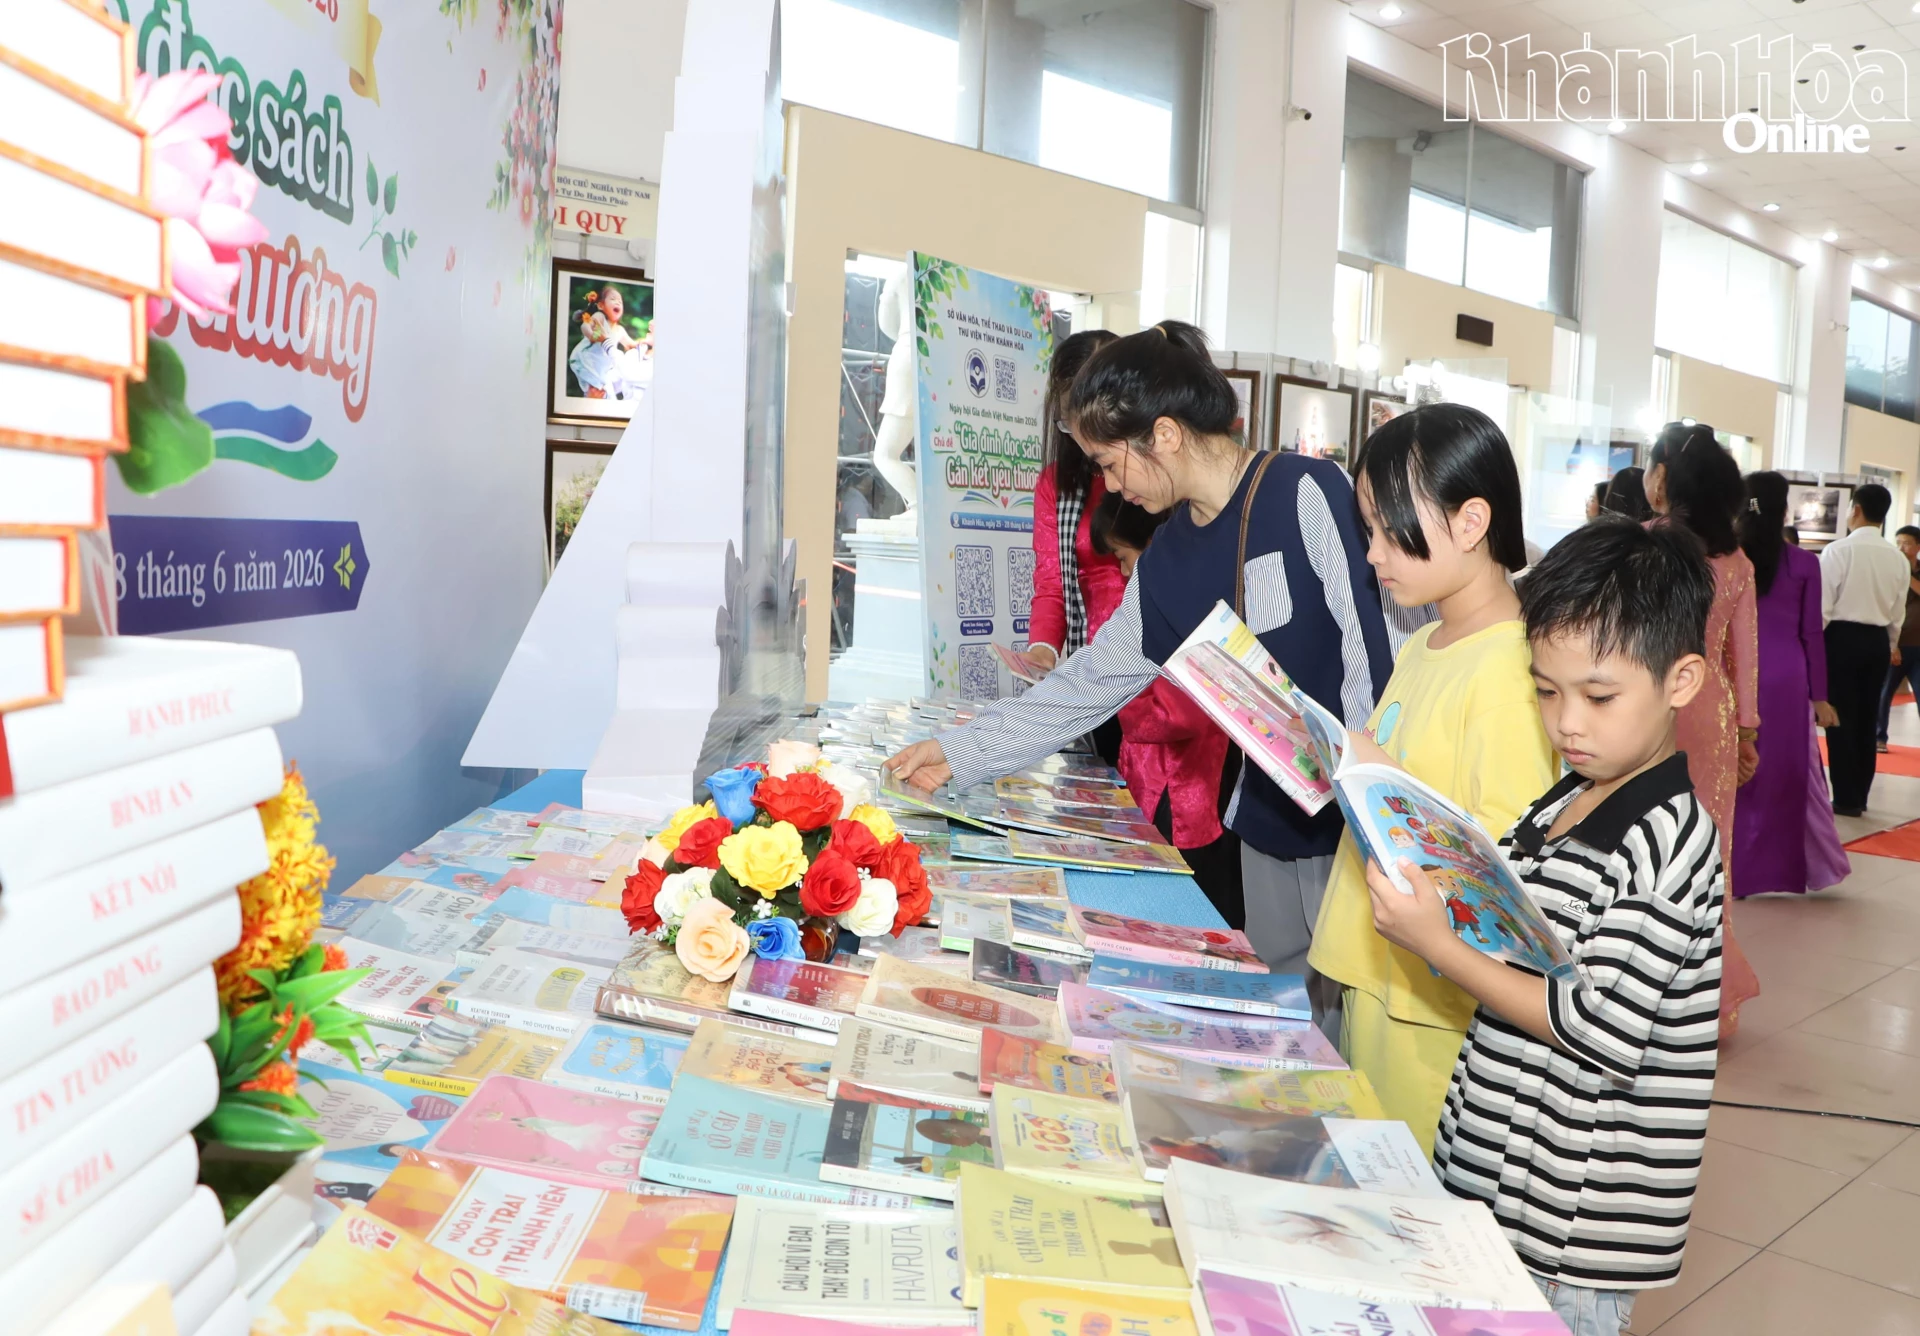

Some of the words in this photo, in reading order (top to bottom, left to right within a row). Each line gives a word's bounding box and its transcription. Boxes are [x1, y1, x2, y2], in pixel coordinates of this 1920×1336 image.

[255, 76, 352, 215] sách
[574, 190, 584, 198] Do
[591, 182, 614, 193] NGHĨA
[616, 187, 633, 197] VIỆT
[635, 190, 650, 199] NAM
[576, 209, 627, 235] QUY
[198, 240, 375, 416] ương
[992, 321, 1005, 332] THAO
[1006, 324, 1013, 334] VÀ
[1014, 327, 1021, 336] DU
[1022, 330, 1032, 340] LỊCH
[996, 336, 1013, 348] KHÁNH
[949, 402, 962, 414] Ngày
[972, 406, 980, 416] Gia
[981, 408, 992, 418] đình
[993, 410, 1002, 422] Việt
[1003, 412, 1014, 422] Nam
[1014, 414, 1024, 424] năm
[1025, 416, 1038, 427] 2026
[934, 436, 945, 447] Chủ
[946, 436, 953, 448] đề
[981, 428, 1000, 455] đình
[1004, 432, 1020, 461] đọc
[1022, 437, 1041, 460] sách
[947, 457, 968, 486] Gắn
[971, 457, 990, 487] kết
[992, 462, 1011, 497] yêu
[1013, 463, 1039, 490] thươn
[113, 553, 128, 600] 8
[137, 549, 206, 607] tháng
[213, 550, 227, 593] 6
[234, 548, 277, 592] năm
[283, 548, 324, 587] 2026
[356, 954, 381, 969] OAN
[52, 977, 100, 1028] BAO
[781, 1008, 798, 1018] Cam
[410, 1077, 438, 1088] Michael
[439, 1082, 466, 1092] Hawton
[14, 1088, 56, 1134] TIN
[710, 1110, 740, 1132] GÁI
[744, 1112, 764, 1134] MINH
[702, 1132, 732, 1150] CÔ
[736, 1182, 754, 1192] CON
[1010, 1194, 1034, 1222] TRAI
[448, 1218, 472, 1243] NUÔI
[466, 1198, 488, 1222] DẠY
[467, 1229, 500, 1258] CON
[488, 1194, 528, 1228] TRAI
[503, 1213, 551, 1266] THÀNH
[539, 1184, 571, 1219] NIÊN
[821, 1220, 850, 1236] TÔI
[788, 1226, 817, 1243] ĐẠI
[1010, 1224, 1044, 1264] CHÀNG
[782, 1243, 812, 1254] VĨ
[824, 1238, 850, 1257] CON
[778, 1256, 811, 1273] HỎI
[816, 1258, 850, 1274] ĐỔI
[891, 1224, 926, 1302] HAVRUTA
[777, 1274, 809, 1292] CÂU
[821, 1276, 850, 1299] THAY
